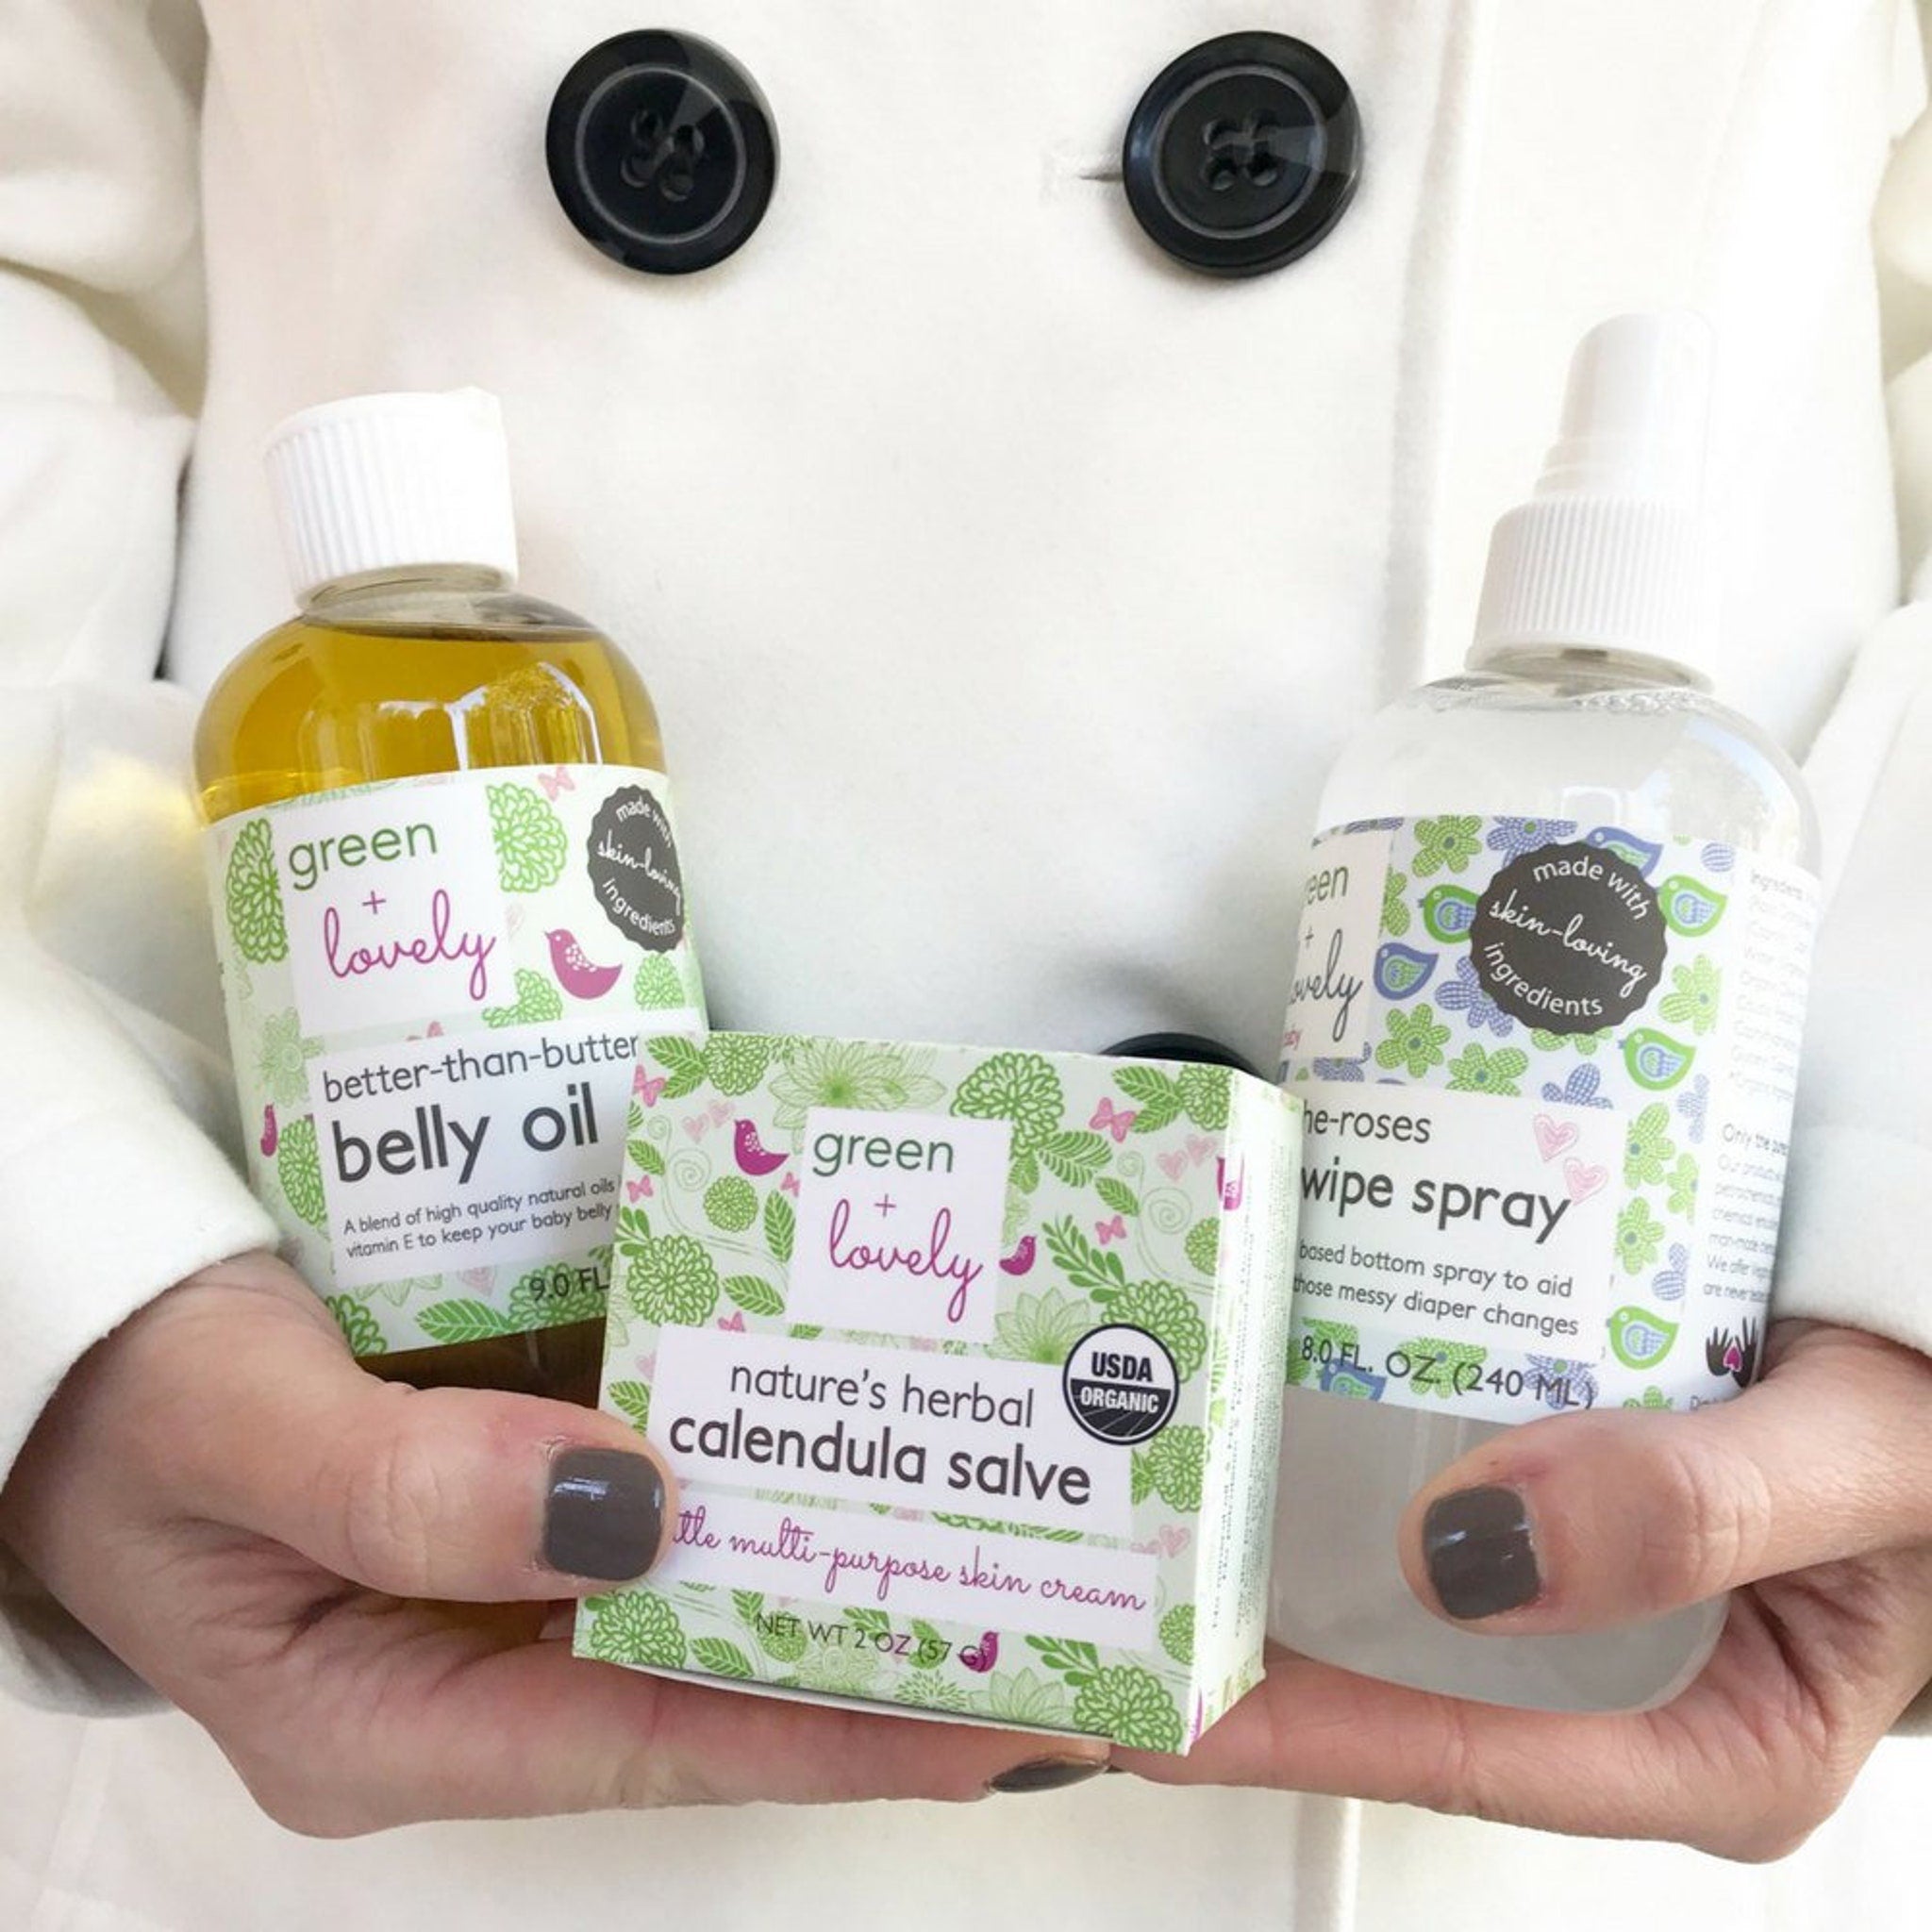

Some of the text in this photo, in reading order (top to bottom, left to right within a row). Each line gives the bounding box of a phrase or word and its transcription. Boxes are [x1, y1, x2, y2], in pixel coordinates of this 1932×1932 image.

[616, 795, 652, 823] made
[288, 823, 437, 891] green
[1305, 865, 1348, 905] een
[361, 891, 387, 915] +
[602, 877, 676, 936] ingredients
[1533, 856, 1651, 920] made with
[323, 890, 496, 1000] lovely
[1489, 889, 1647, 998] skin-loving
[1484, 941, 1603, 1017] ingredients
[323, 1034, 639, 1103] better-than-butter
[332, 1081, 598, 1185] belly oil
[1304, 1099, 1431, 1143] he-roses
[812, 1132, 954, 1176] green
[343, 1177, 615, 1235] A blend of high quality natural oils
[346, 1203, 612, 1258] vitamin E to keep your baby belly
[875, 1194, 896, 1217] +
[1301, 1157, 1572, 1244] wipe spray
[529, 1273, 569, 1301] 9.0
[829, 1198, 982, 1323] lovely
[1299, 1239, 1573, 1298] based bottom spray to aid
[1292, 1274, 1579, 1338] those messy diaper changes
[730, 1364, 1033, 1428] nature's herbal
[1091, 1352, 1153, 1382] USDA
[1302, 1336, 1593, 1409] 8.0 FL. OZ. (240 ML)
[1081, 1387, 1159, 1413] ORGANIC
[670, 1407, 1091, 1506] calendula salve
[729, 1517, 950, 1601] multi-purpose
[959, 1545, 1031, 1594] skin
[1041, 1579, 1146, 1610] cream
[756, 1612, 800, 1637] NET
[808, 1620, 848, 1645] WT
[855, 1628, 866, 1649] 2
[874, 1632, 912, 1656] OZ
[917, 1639, 953, 1663] (57
